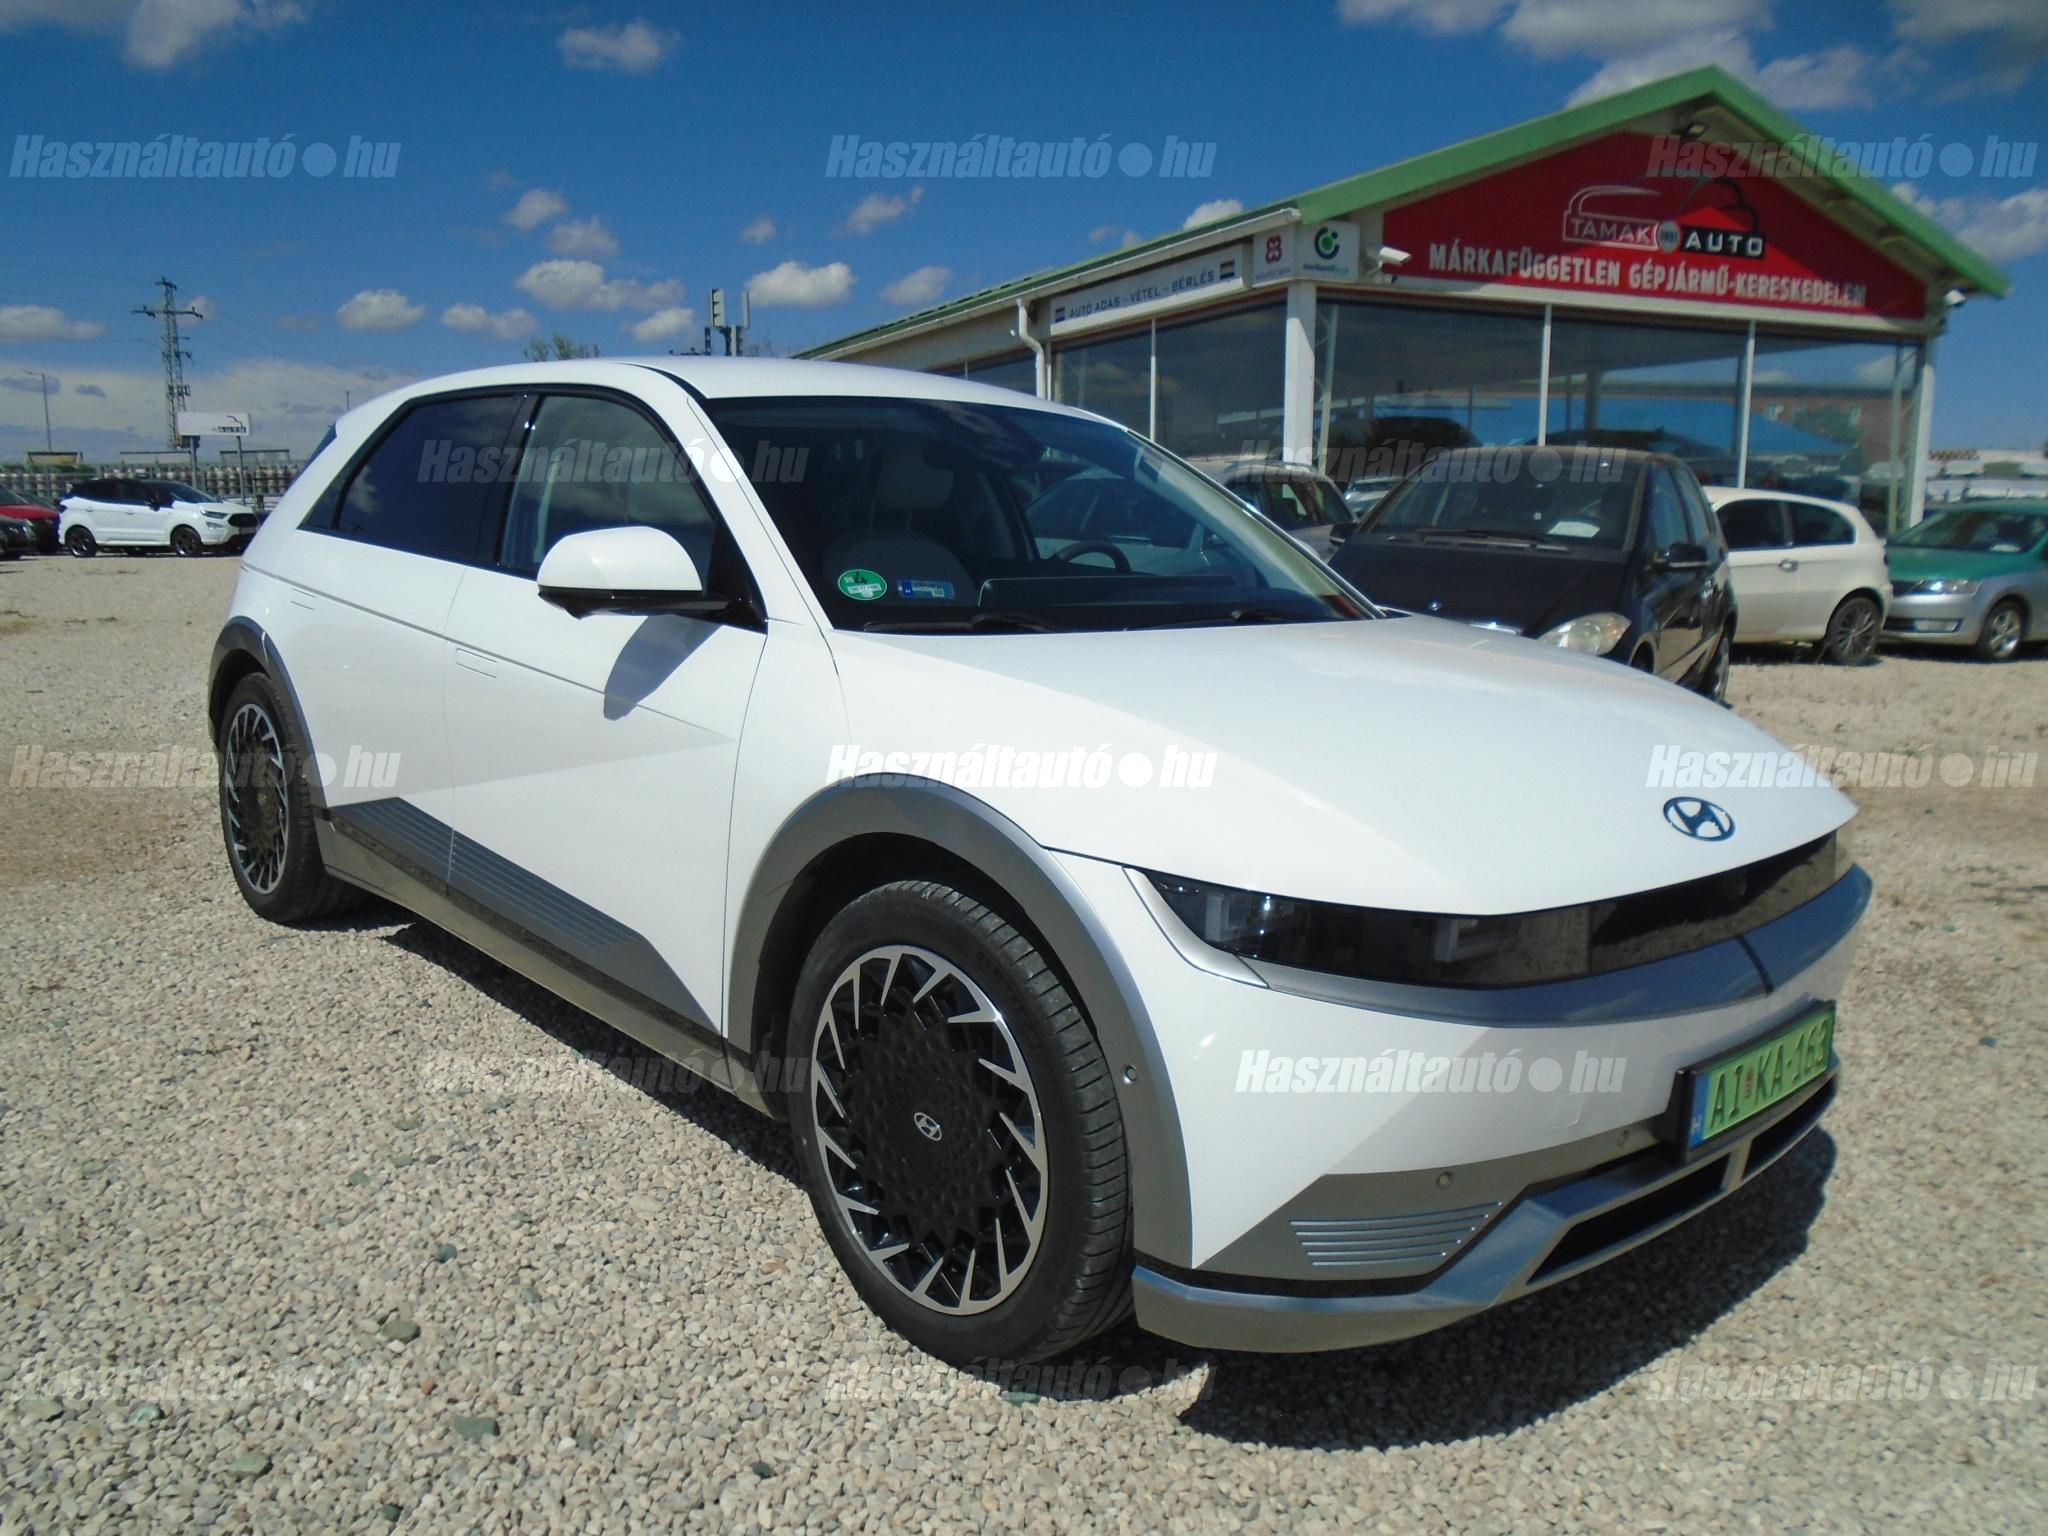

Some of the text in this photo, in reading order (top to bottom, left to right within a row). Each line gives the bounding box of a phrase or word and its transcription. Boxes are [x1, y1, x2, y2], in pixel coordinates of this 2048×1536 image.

[1571, 218, 1650, 242] TAMAK
[1686, 231, 1764, 257] AUTO
[1171, 270, 1215, 293] BÉRLÉS
[1429, 238, 1621, 288] MÁRKAFÜGGETLEN
